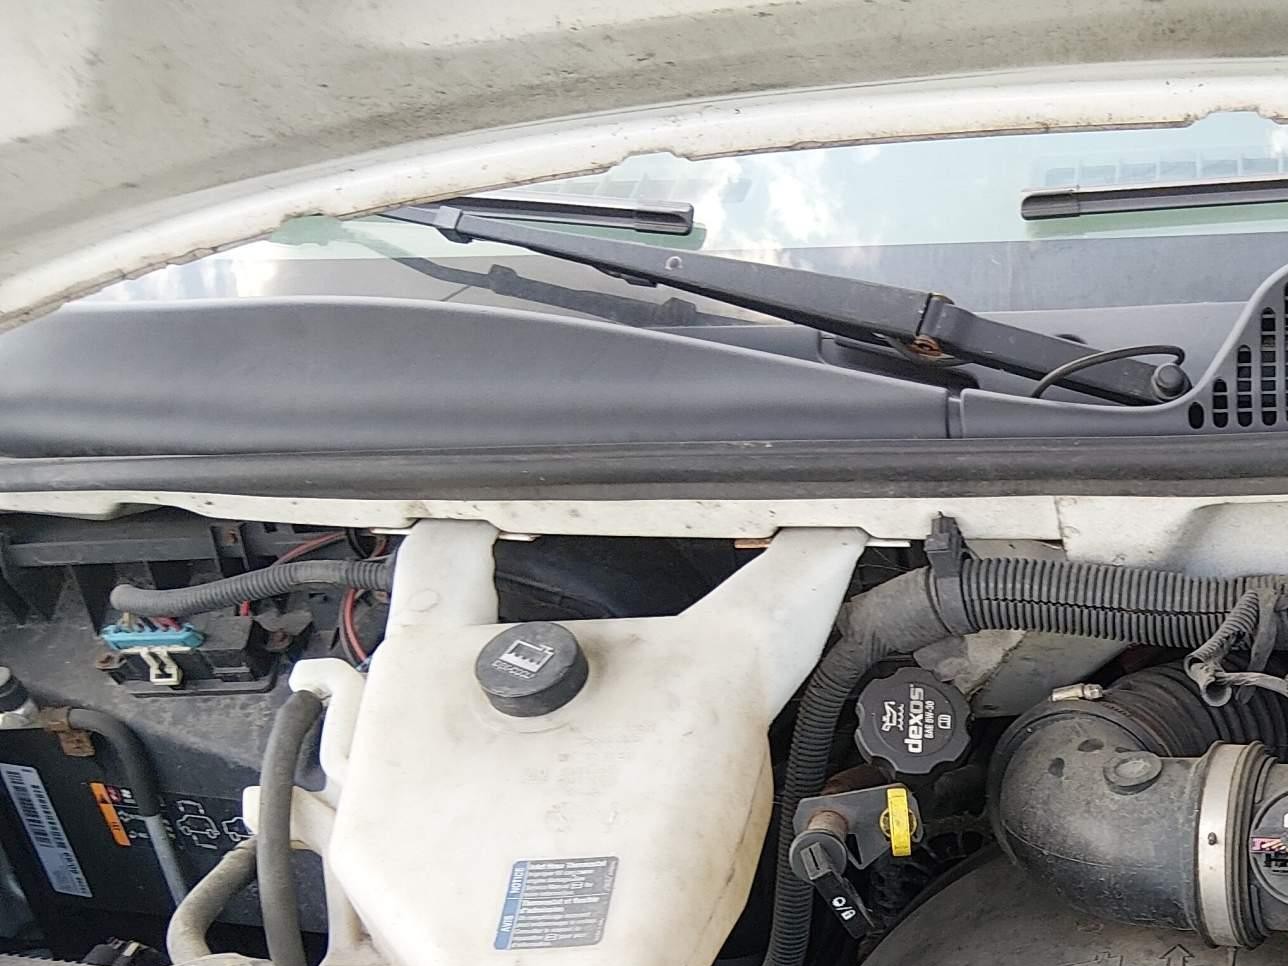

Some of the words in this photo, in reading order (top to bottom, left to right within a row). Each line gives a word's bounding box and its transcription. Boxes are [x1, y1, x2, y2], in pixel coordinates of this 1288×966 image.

[904, 685, 925, 753] dexos
[510, 867, 525, 894] NOTICE
[501, 915, 514, 933] AVIS
